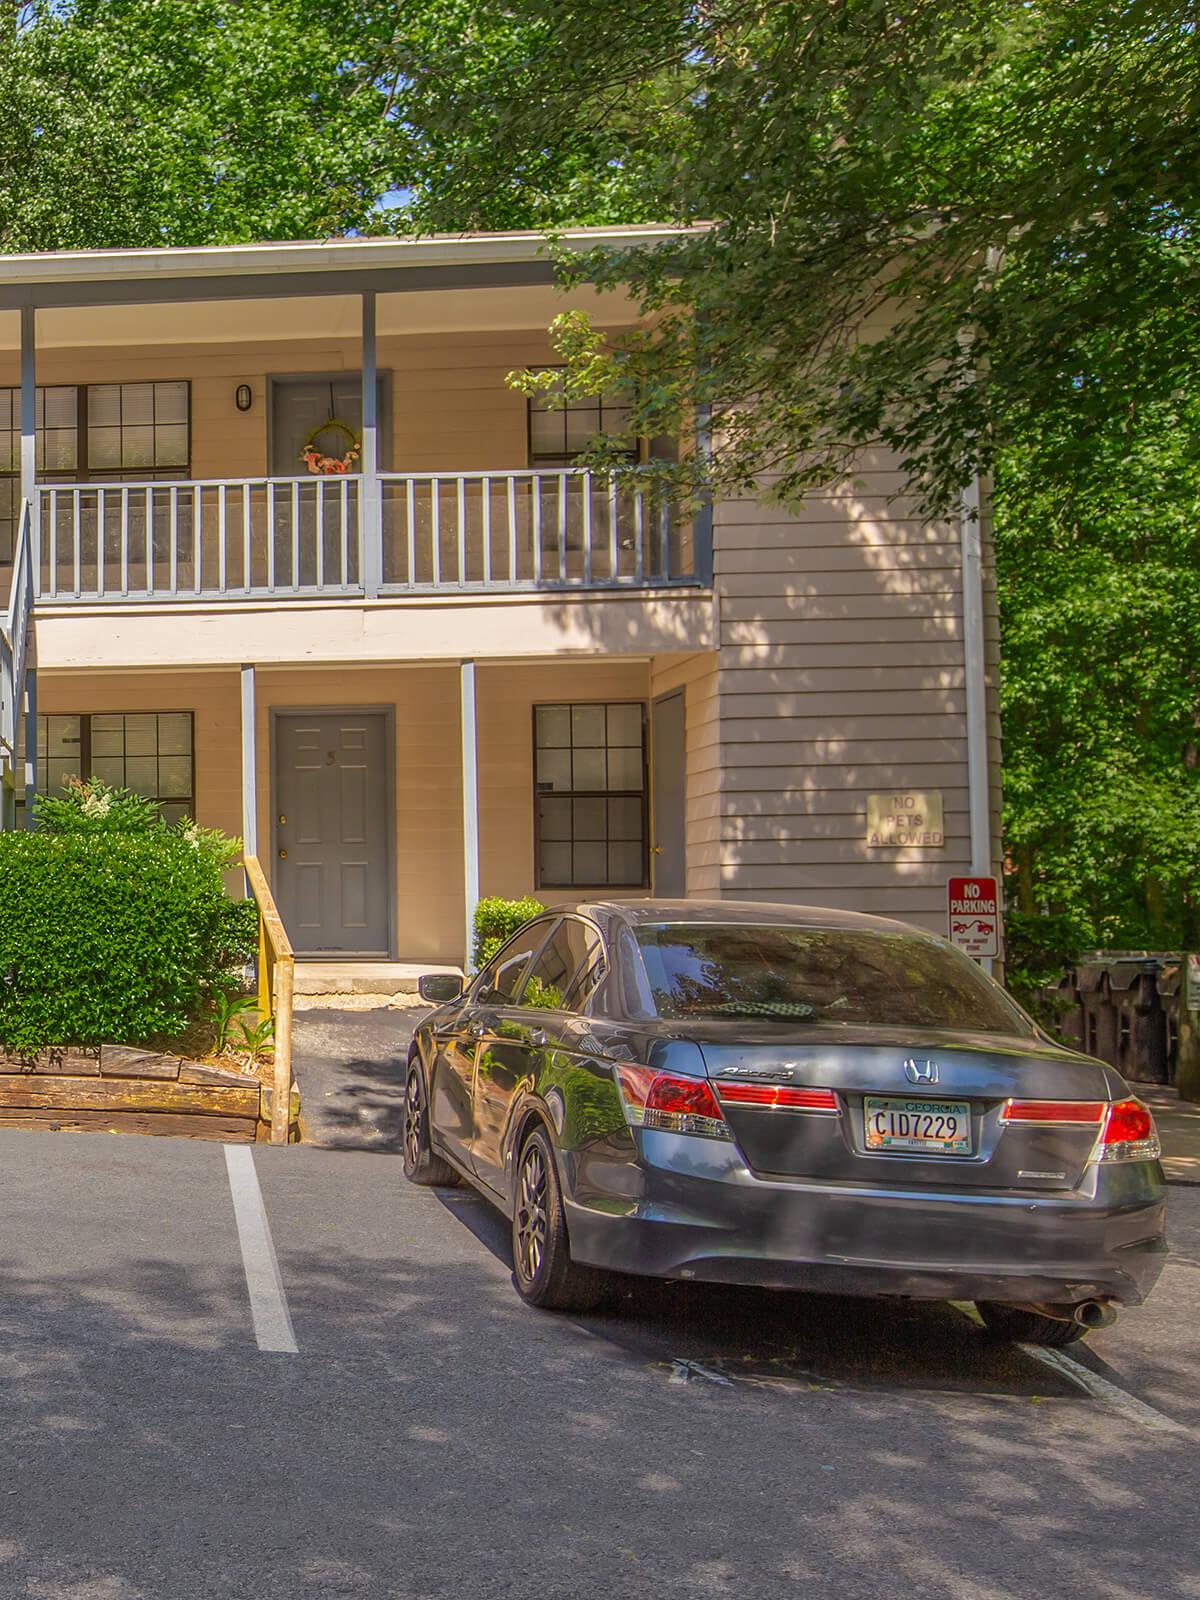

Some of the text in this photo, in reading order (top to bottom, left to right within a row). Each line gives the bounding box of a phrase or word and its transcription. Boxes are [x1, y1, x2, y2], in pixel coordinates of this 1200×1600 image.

[894, 796, 915, 809] NO
[886, 814, 923, 827] PETS
[870, 831, 943, 845] ALLOWED
[963, 883, 980, 898] NO
[951, 899, 995, 913] PARKING
[905, 1102, 961, 1114] GEORGIA
[874, 1112, 958, 1139] CID7229
